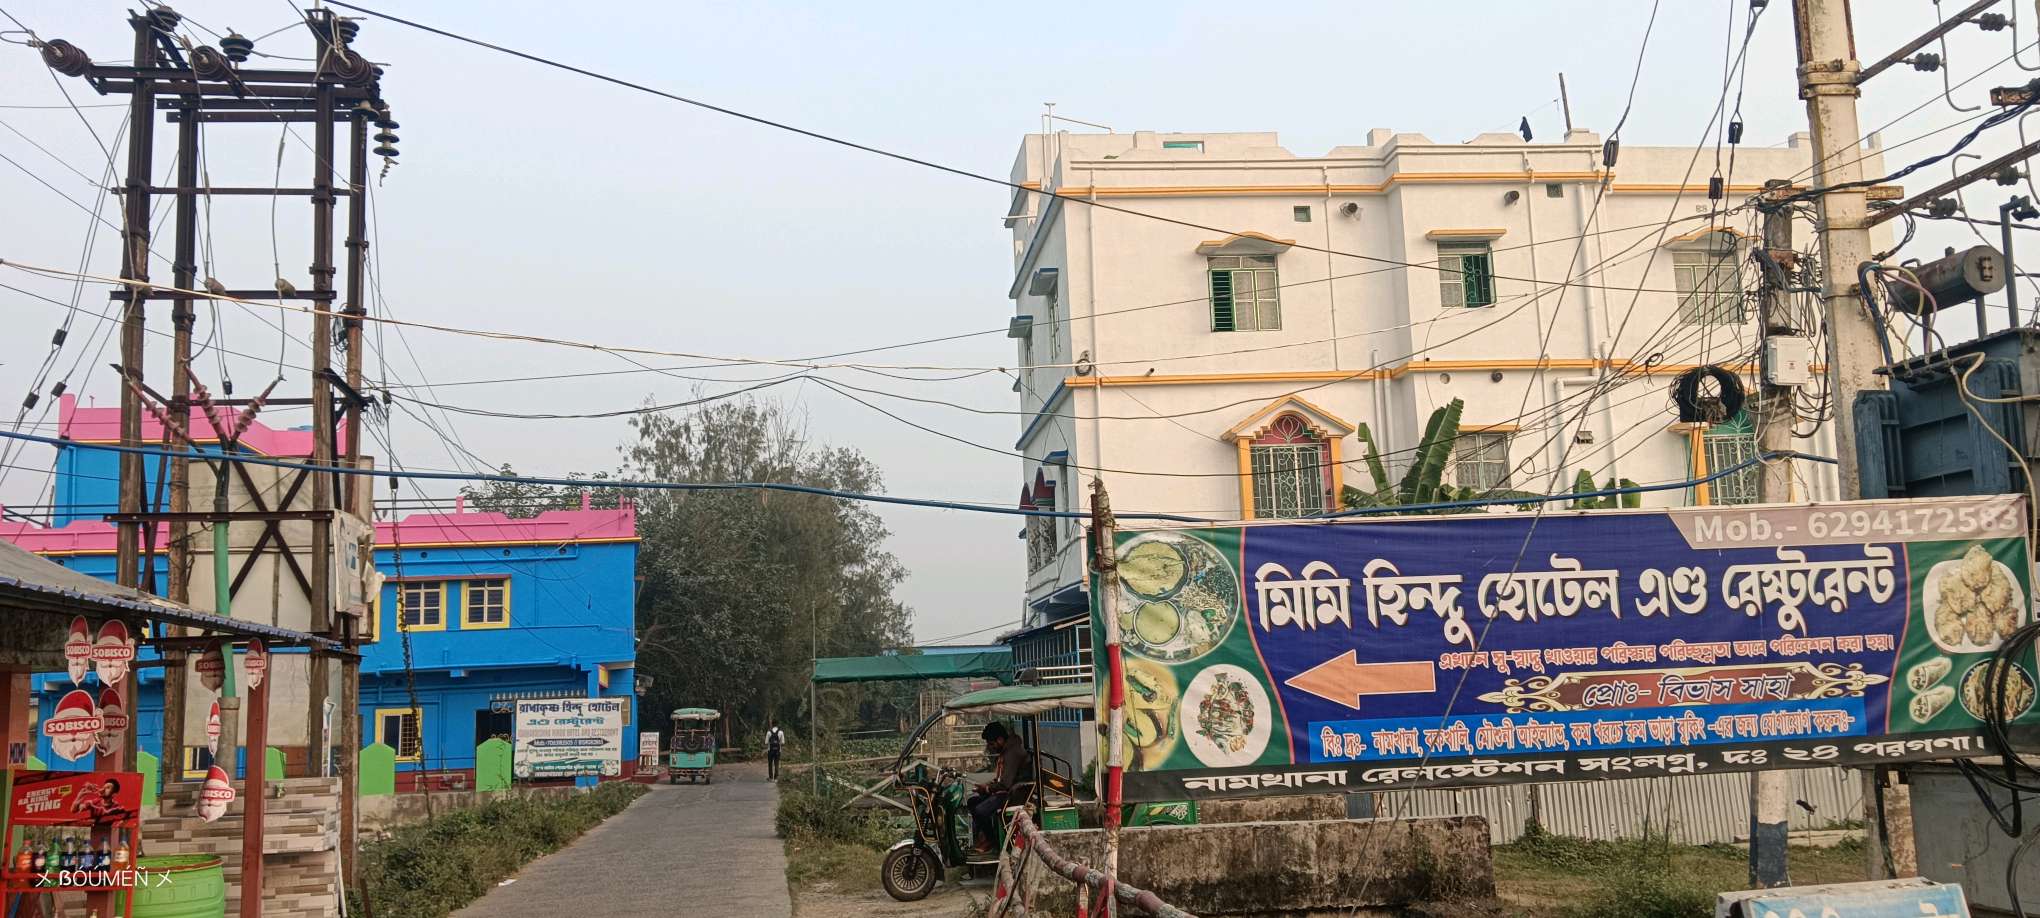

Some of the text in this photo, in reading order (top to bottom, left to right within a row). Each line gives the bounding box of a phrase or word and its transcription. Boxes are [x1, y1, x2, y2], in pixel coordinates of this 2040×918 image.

[1694, 504, 2019, 543] Mob.- 6294172583
[1255, 560, 1352, 632] মিমি
[1362, 558, 1477, 650] হিন্দু
[1478, 553, 1622, 623] হোটেল
[92, 647, 131, 658] SOBISCO
[1733, 639, 1767, 657] ভাবে
[1770, 634, 1834, 656] পরিবেশন
[1837, 636, 1863, 653] করা
[1658, 674, 1735, 705] বিভাস
[1739, 672, 1795, 699] সাহা
[47, 720, 101, 733] SOBISCO
[1570, 722, 1591, 746] কম
[1593, 719, 1623, 744] খরচে
[1649, 716, 1676, 746] ভাড়া
[1677, 710, 1706, 746] বুকিং
[1734, 714, 1758, 738] জন্য
[1760, 709, 1812, 736] যোগাযোগ
[1183, 770, 1347, 792] নামখানা
[1361, 758, 1565, 785] রেলস্টেশন
[1782, 744, 1839, 761] ২৪
[25, 799, 62, 813] STING
